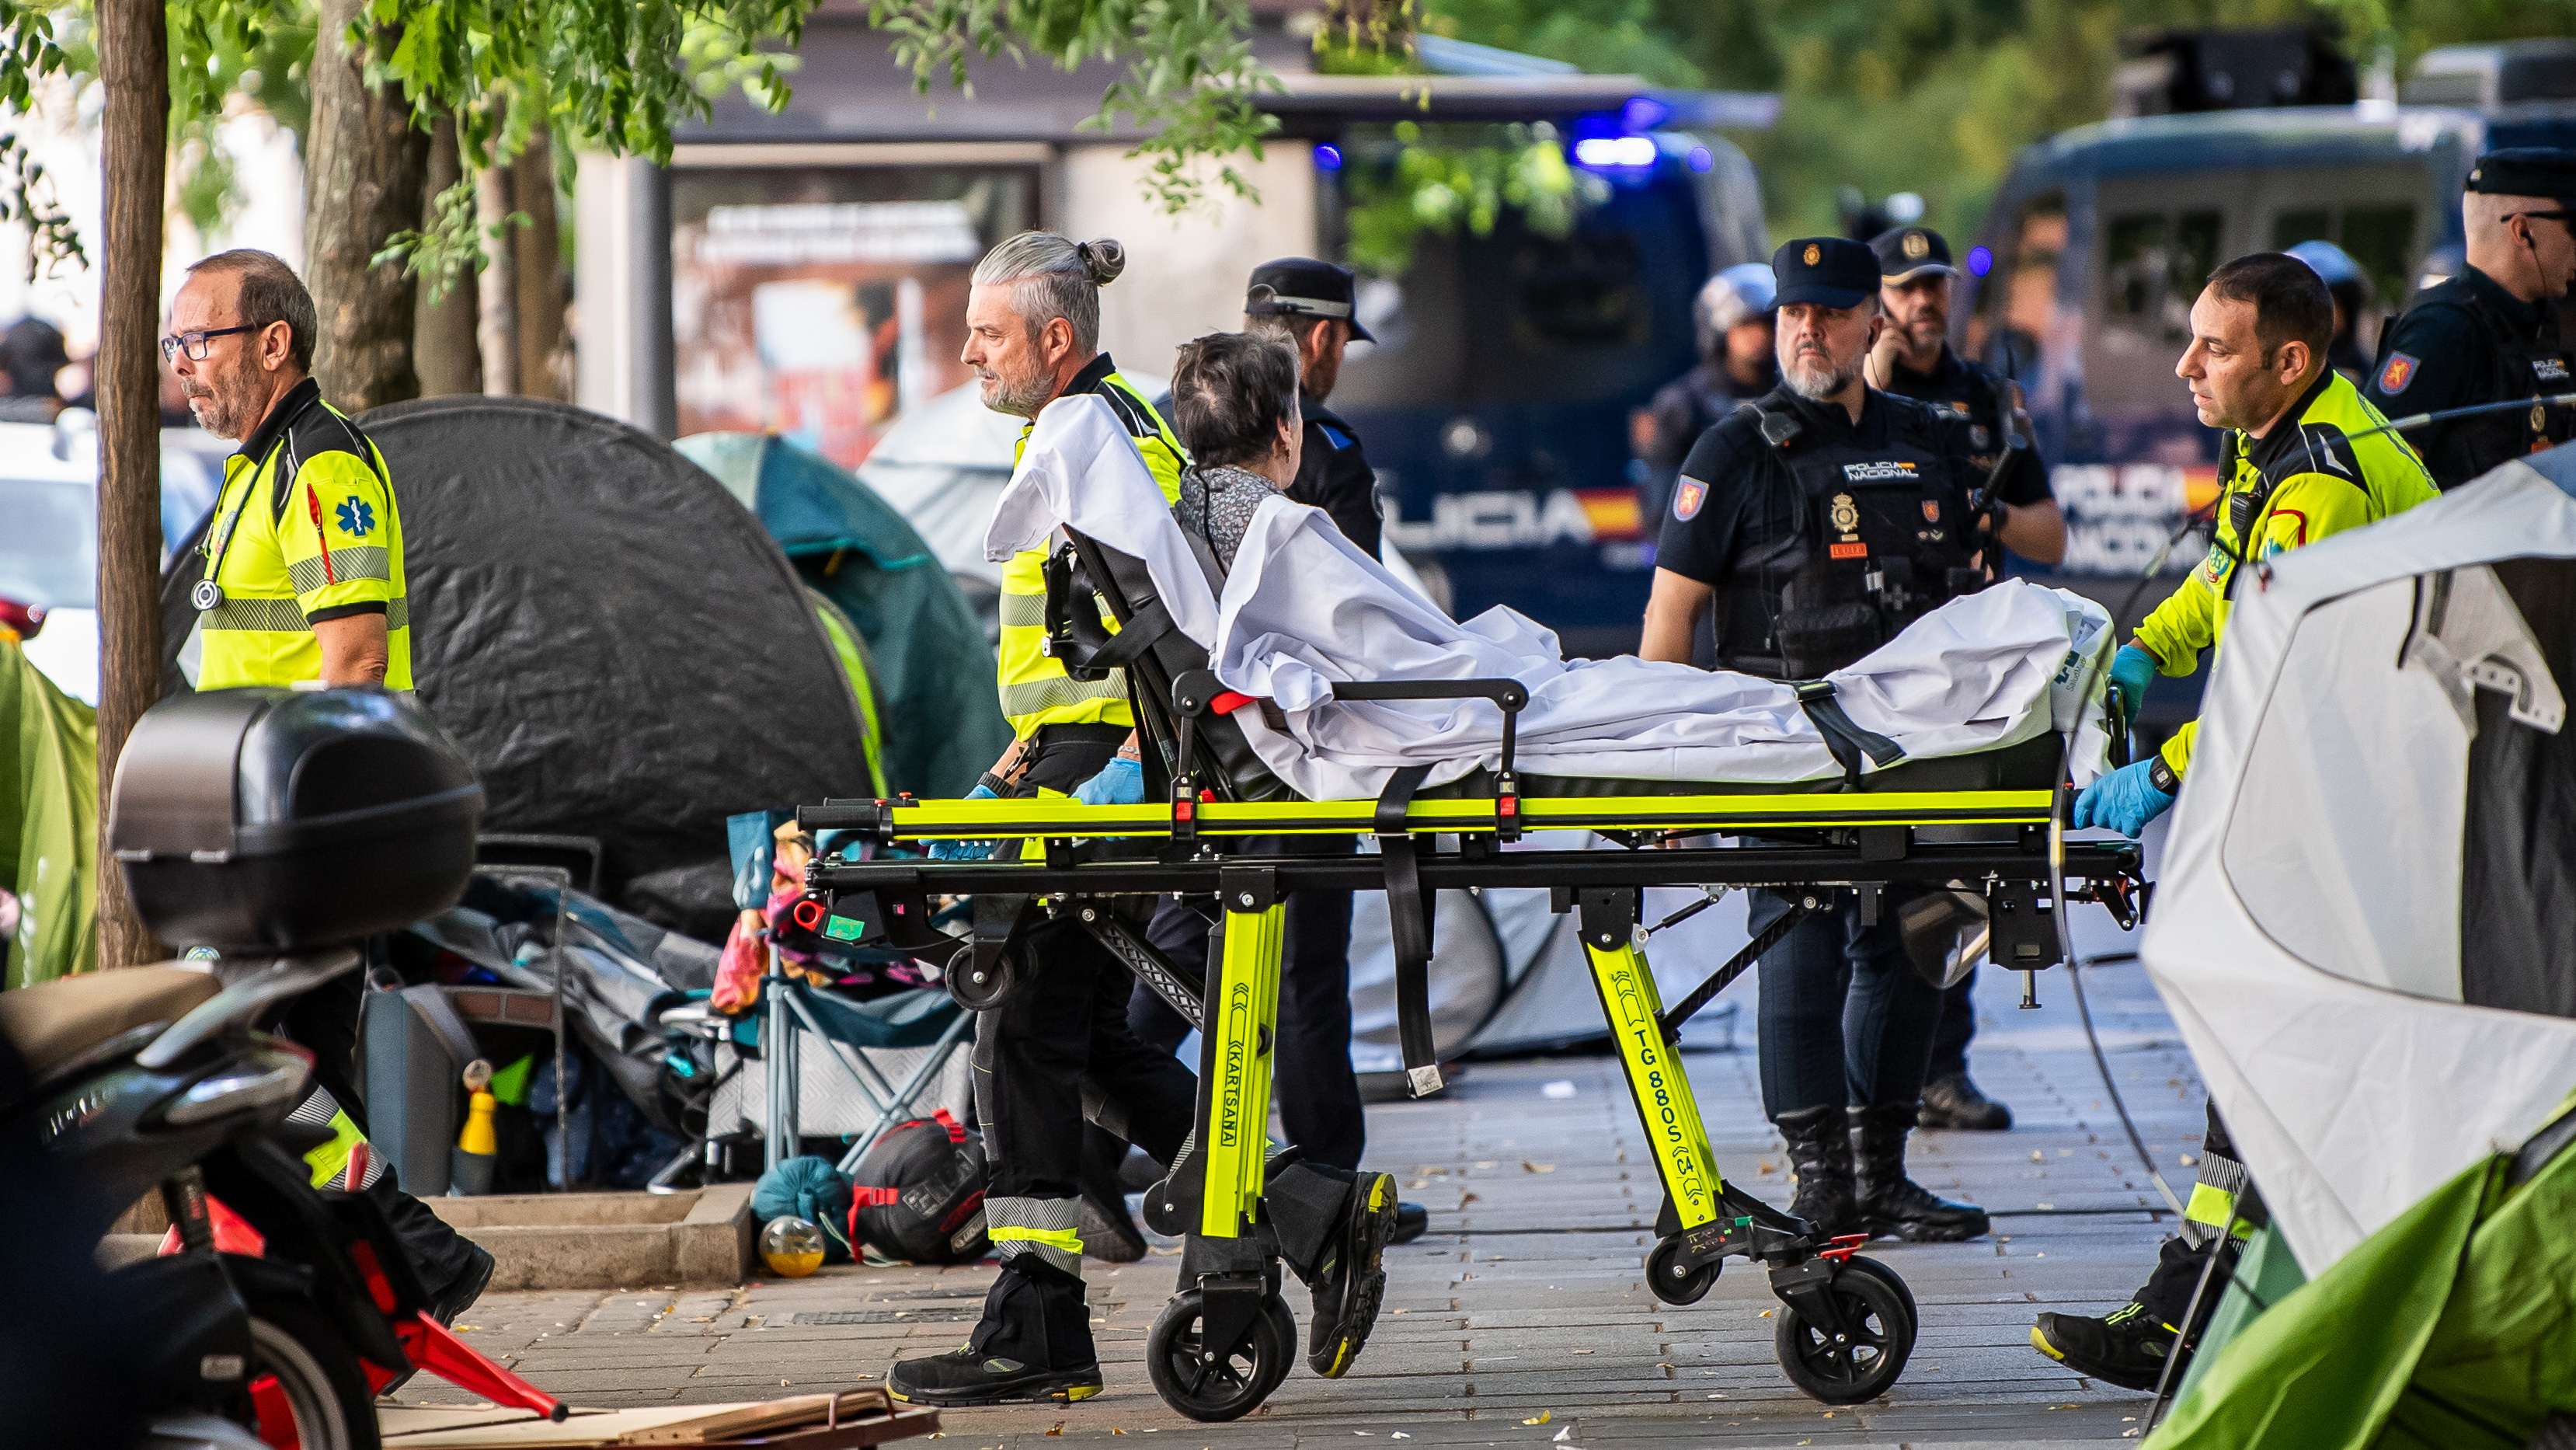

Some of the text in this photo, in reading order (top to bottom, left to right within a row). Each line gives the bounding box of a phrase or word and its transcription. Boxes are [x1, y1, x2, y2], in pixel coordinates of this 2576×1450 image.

[1844, 462, 1902, 472] POLICIA
[1847, 469, 1919, 481] NACIONAL
[1380, 487, 1596, 549] LICIA
[1634, 1029, 1656, 1065] TG
[1223, 1051, 1241, 1142] KARTSANA
